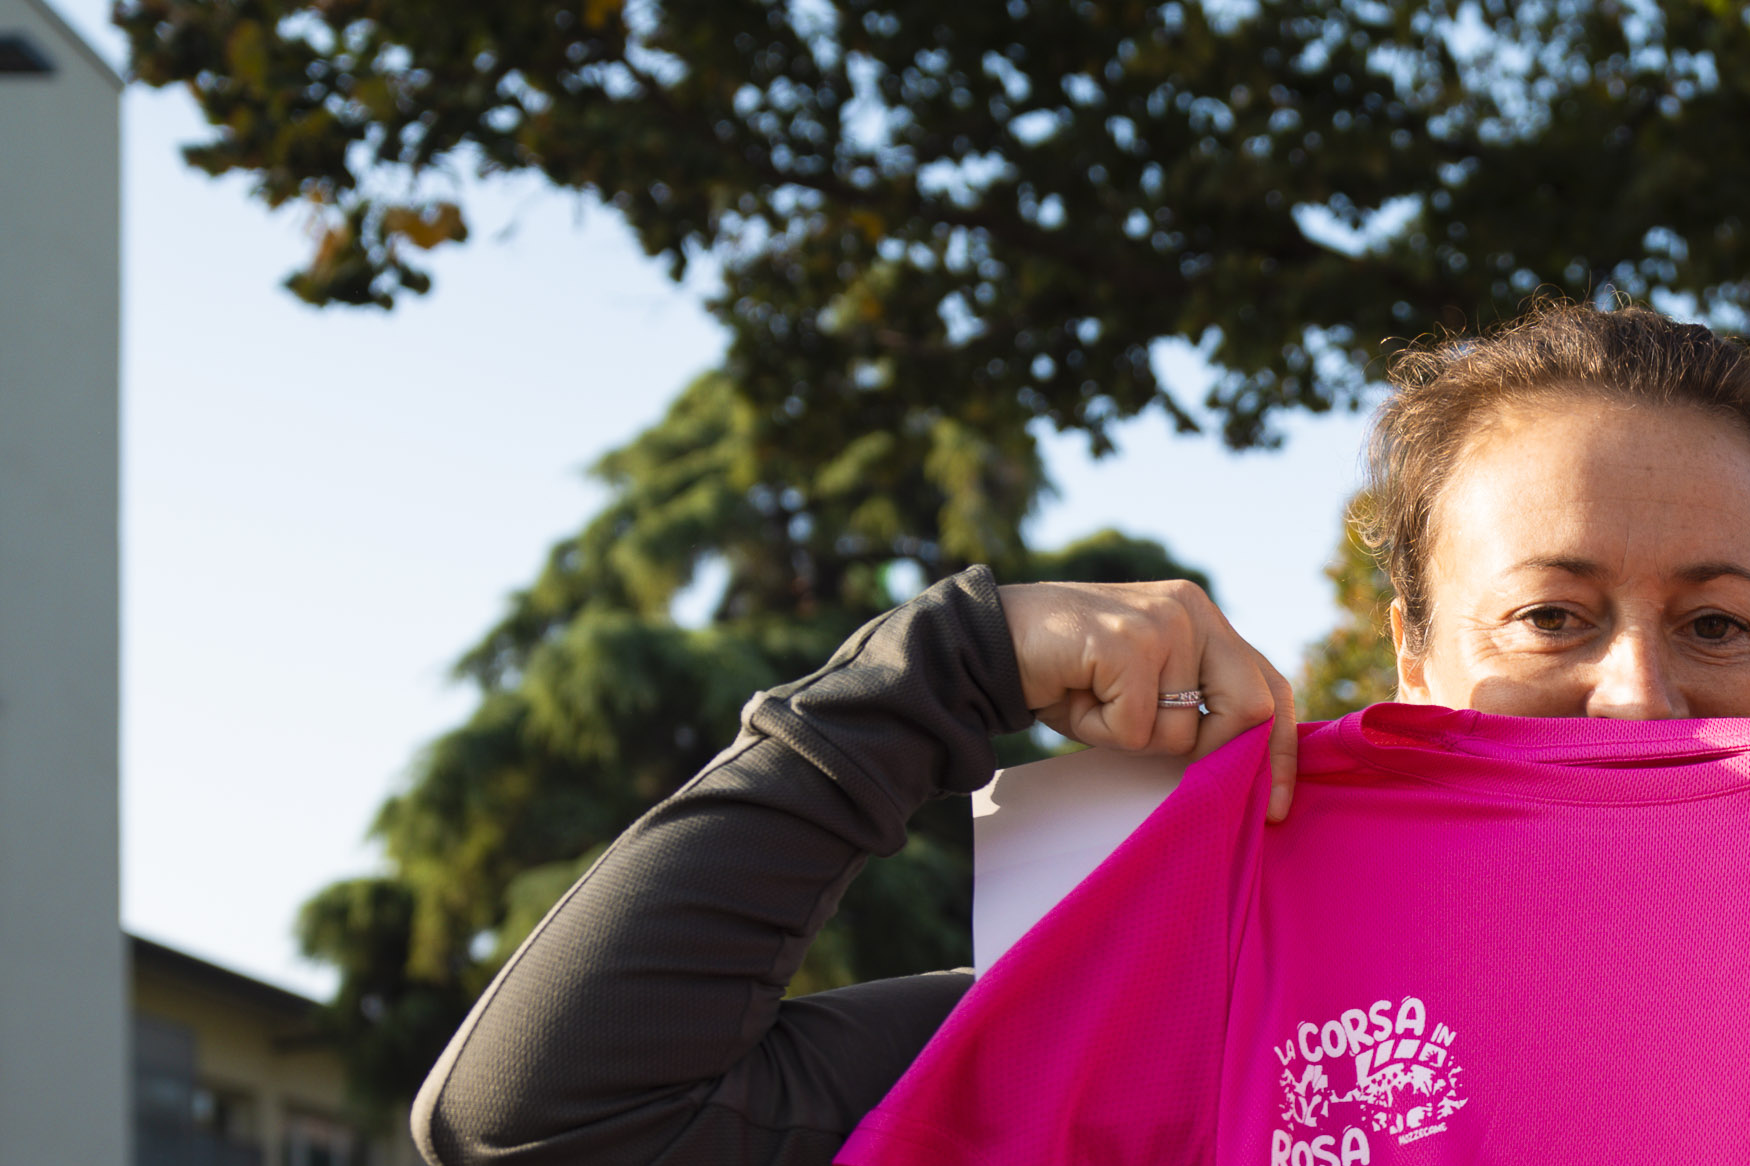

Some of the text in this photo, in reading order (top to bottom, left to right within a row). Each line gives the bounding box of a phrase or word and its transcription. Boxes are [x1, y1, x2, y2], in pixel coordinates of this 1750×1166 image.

[1274, 996, 1457, 1066] LA CORSA IN
